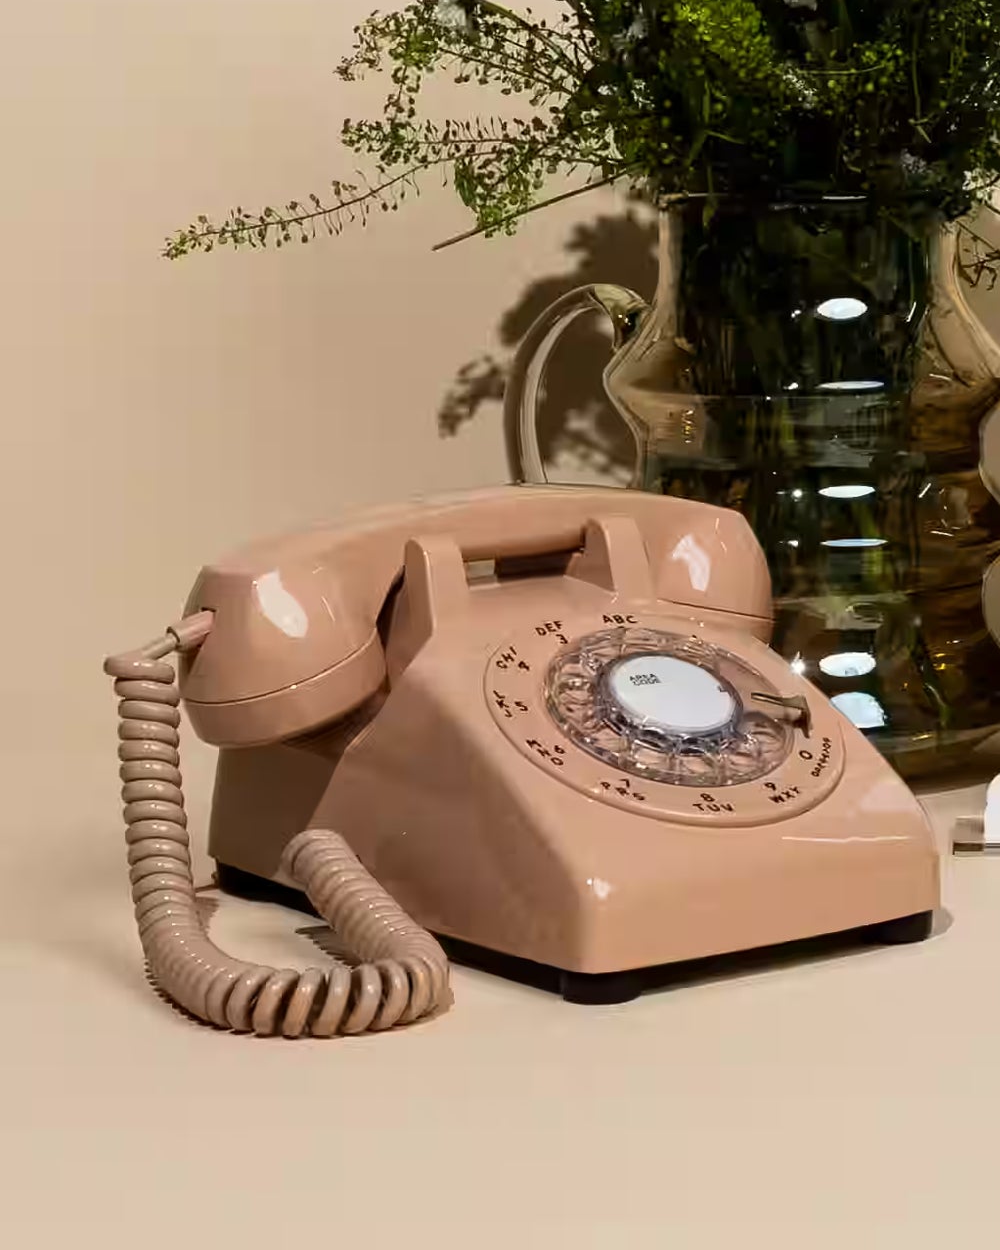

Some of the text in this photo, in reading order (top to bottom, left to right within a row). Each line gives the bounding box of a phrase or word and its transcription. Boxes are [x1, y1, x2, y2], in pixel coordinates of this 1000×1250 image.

[602, 614, 637, 625] ABC
[535, 620, 564, 636] DEF
[555, 634, 568, 644] 3
[514, 701, 529, 712] 5
[554, 745, 566, 755] 6
[618, 778, 631, 789] 7
[764, 781, 777, 791] 9
[768, 786, 801, 804] WXY
[692, 803, 734, 812] TUV
